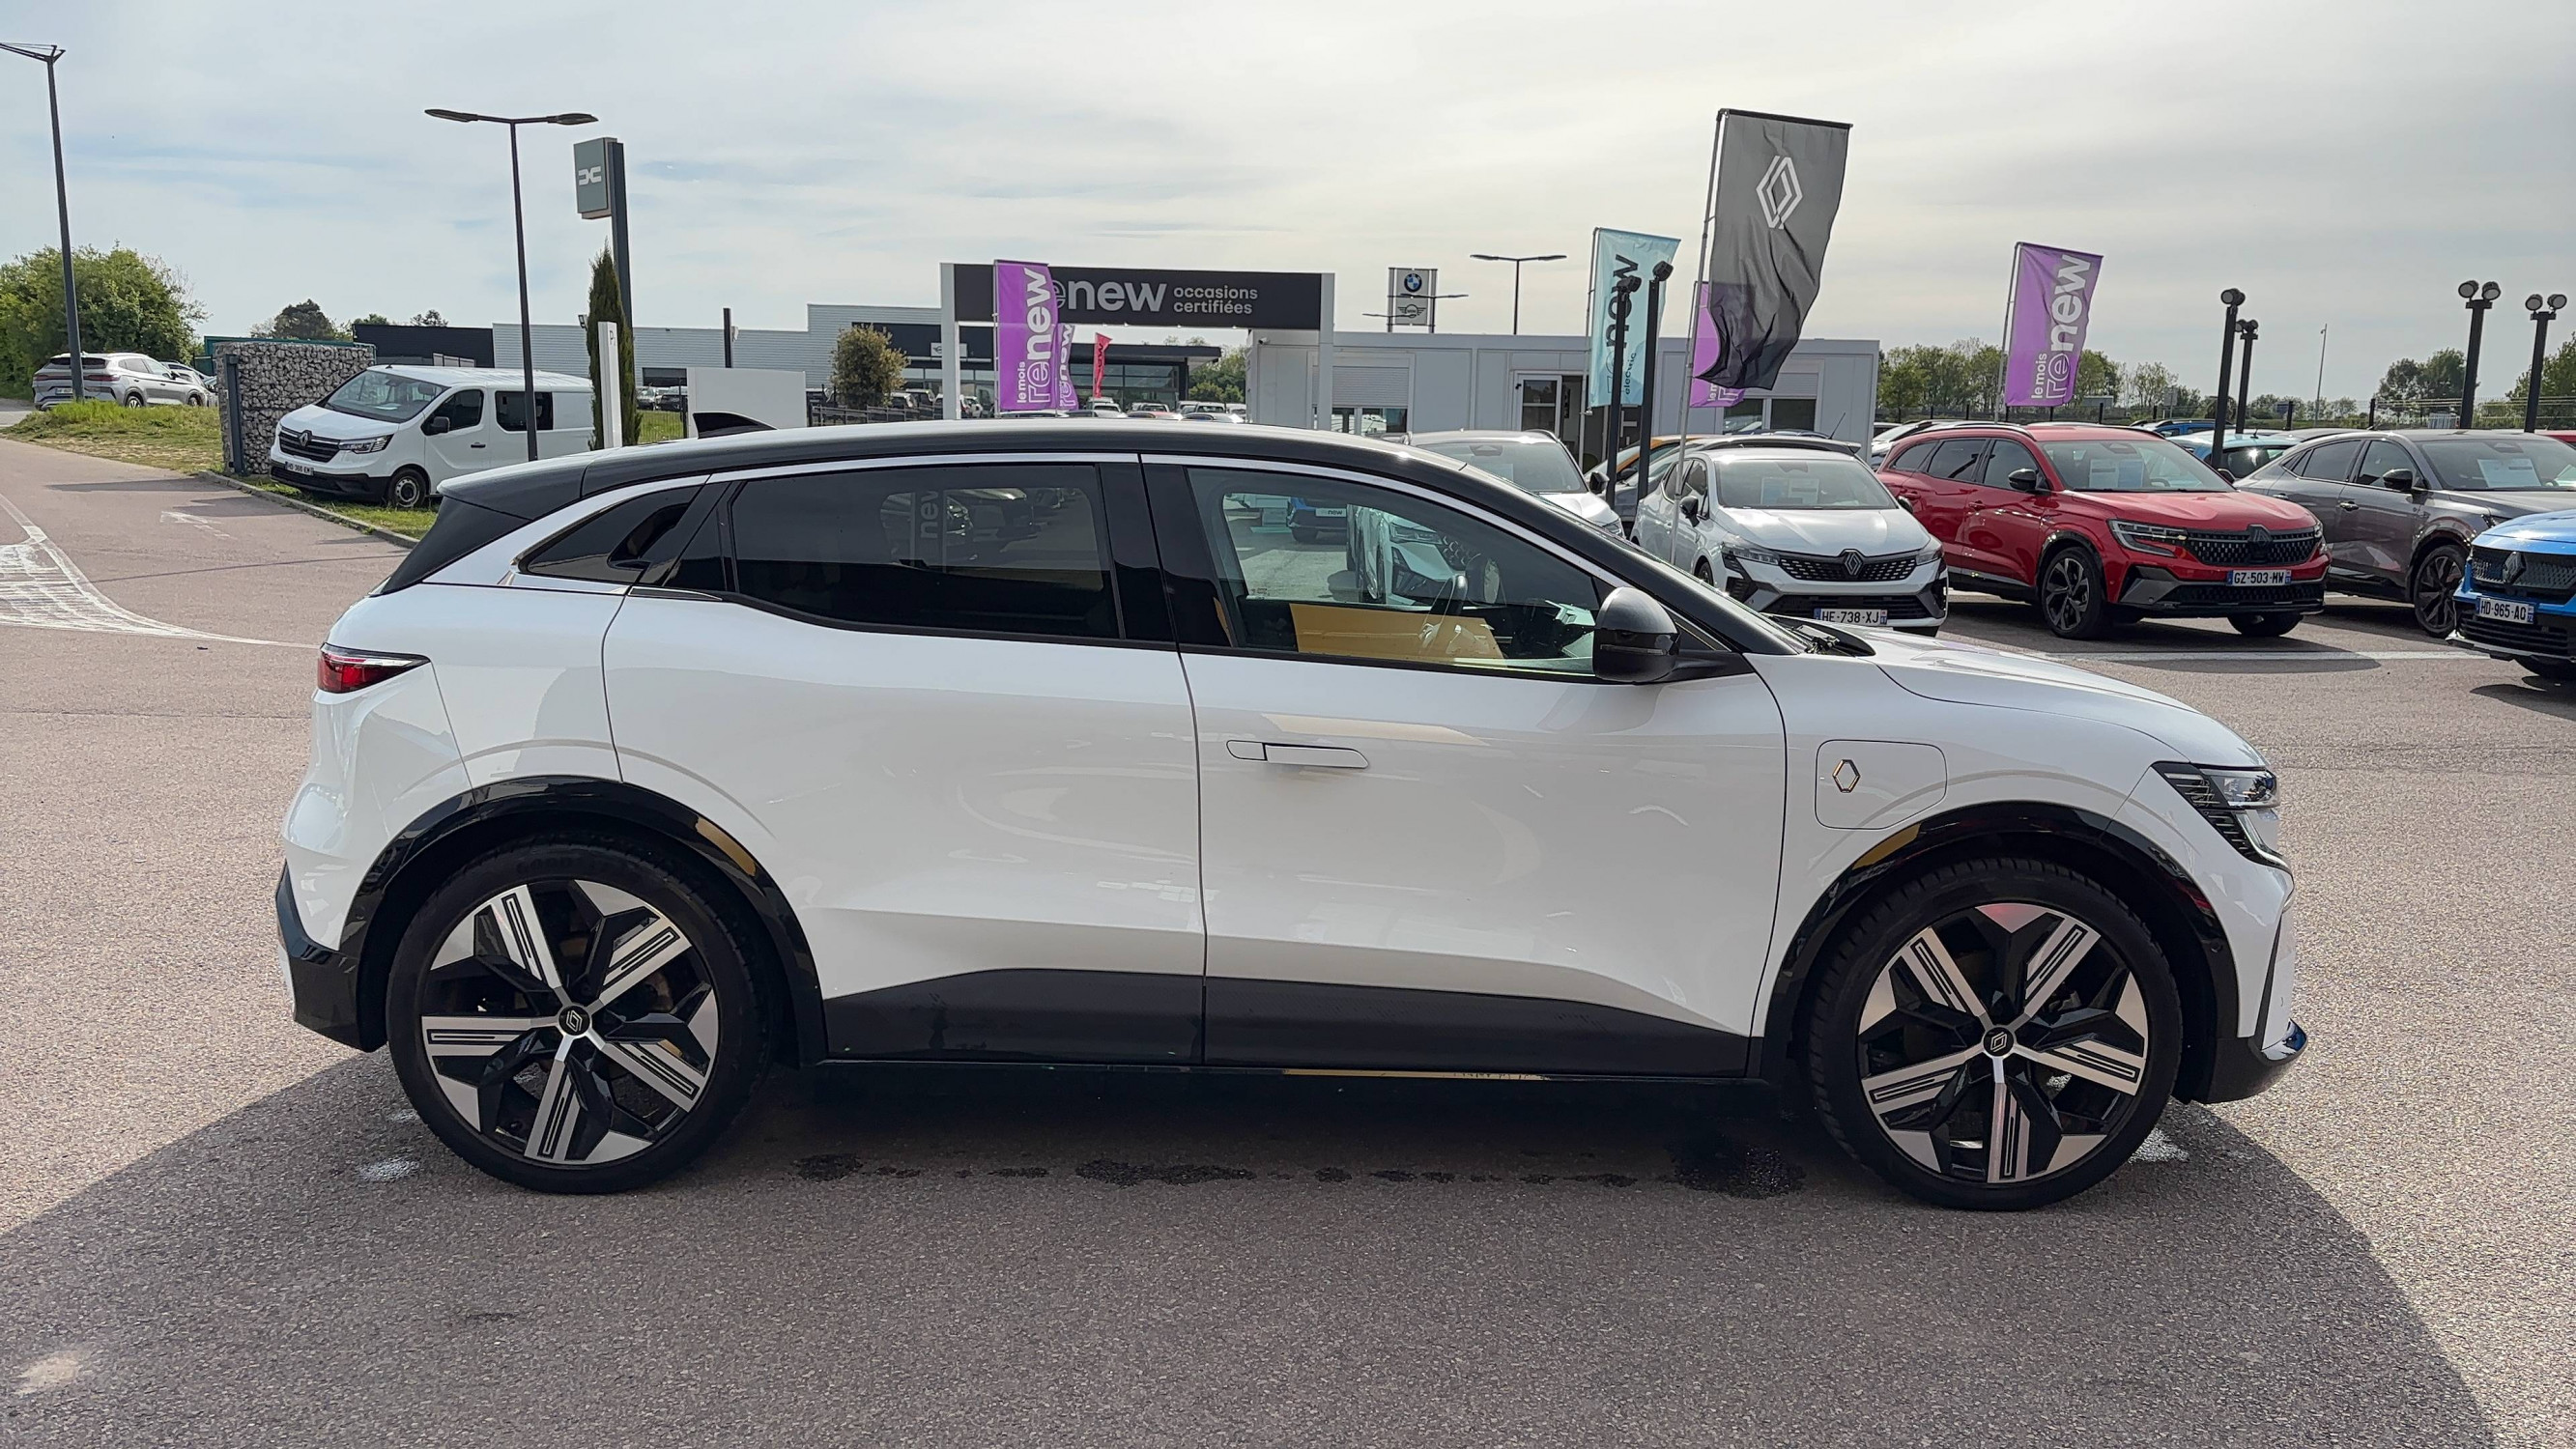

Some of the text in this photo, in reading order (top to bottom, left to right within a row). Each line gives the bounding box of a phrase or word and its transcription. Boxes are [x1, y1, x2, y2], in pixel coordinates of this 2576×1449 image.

[1174, 285, 1258, 299] occasions
[1174, 299, 1252, 315] certifiées
[1024, 267, 1051, 403] renew
[2046, 254, 2091, 399] renew
[1017, 361, 1026, 403] le mois
[2031, 353, 2047, 399] le mois
[1821, 611, 1879, 624] HE-738-XJ
